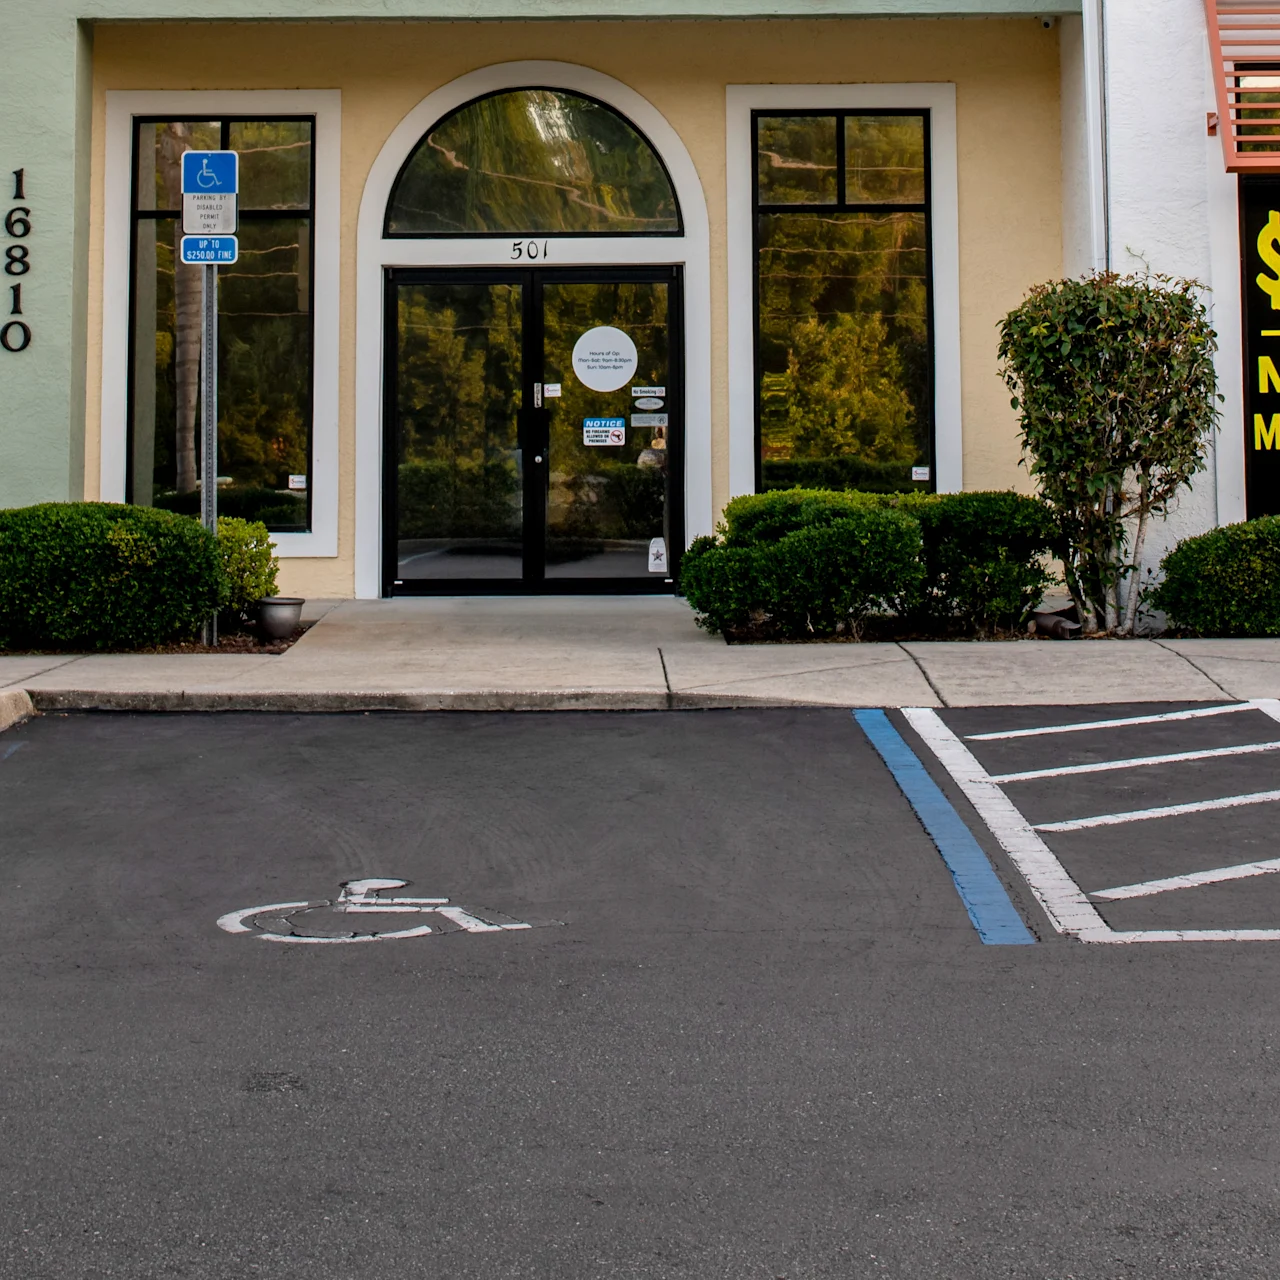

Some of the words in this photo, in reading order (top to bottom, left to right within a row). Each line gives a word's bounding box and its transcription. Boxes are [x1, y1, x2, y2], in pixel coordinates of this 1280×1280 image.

[198, 239, 208, 249] UP
[211, 239, 220, 249] TO
[510, 240, 548, 260] 501
[0, 167, 32, 353] 16810
[186, 250, 215, 260] $250.00
[217, 250, 233, 260] FINE
